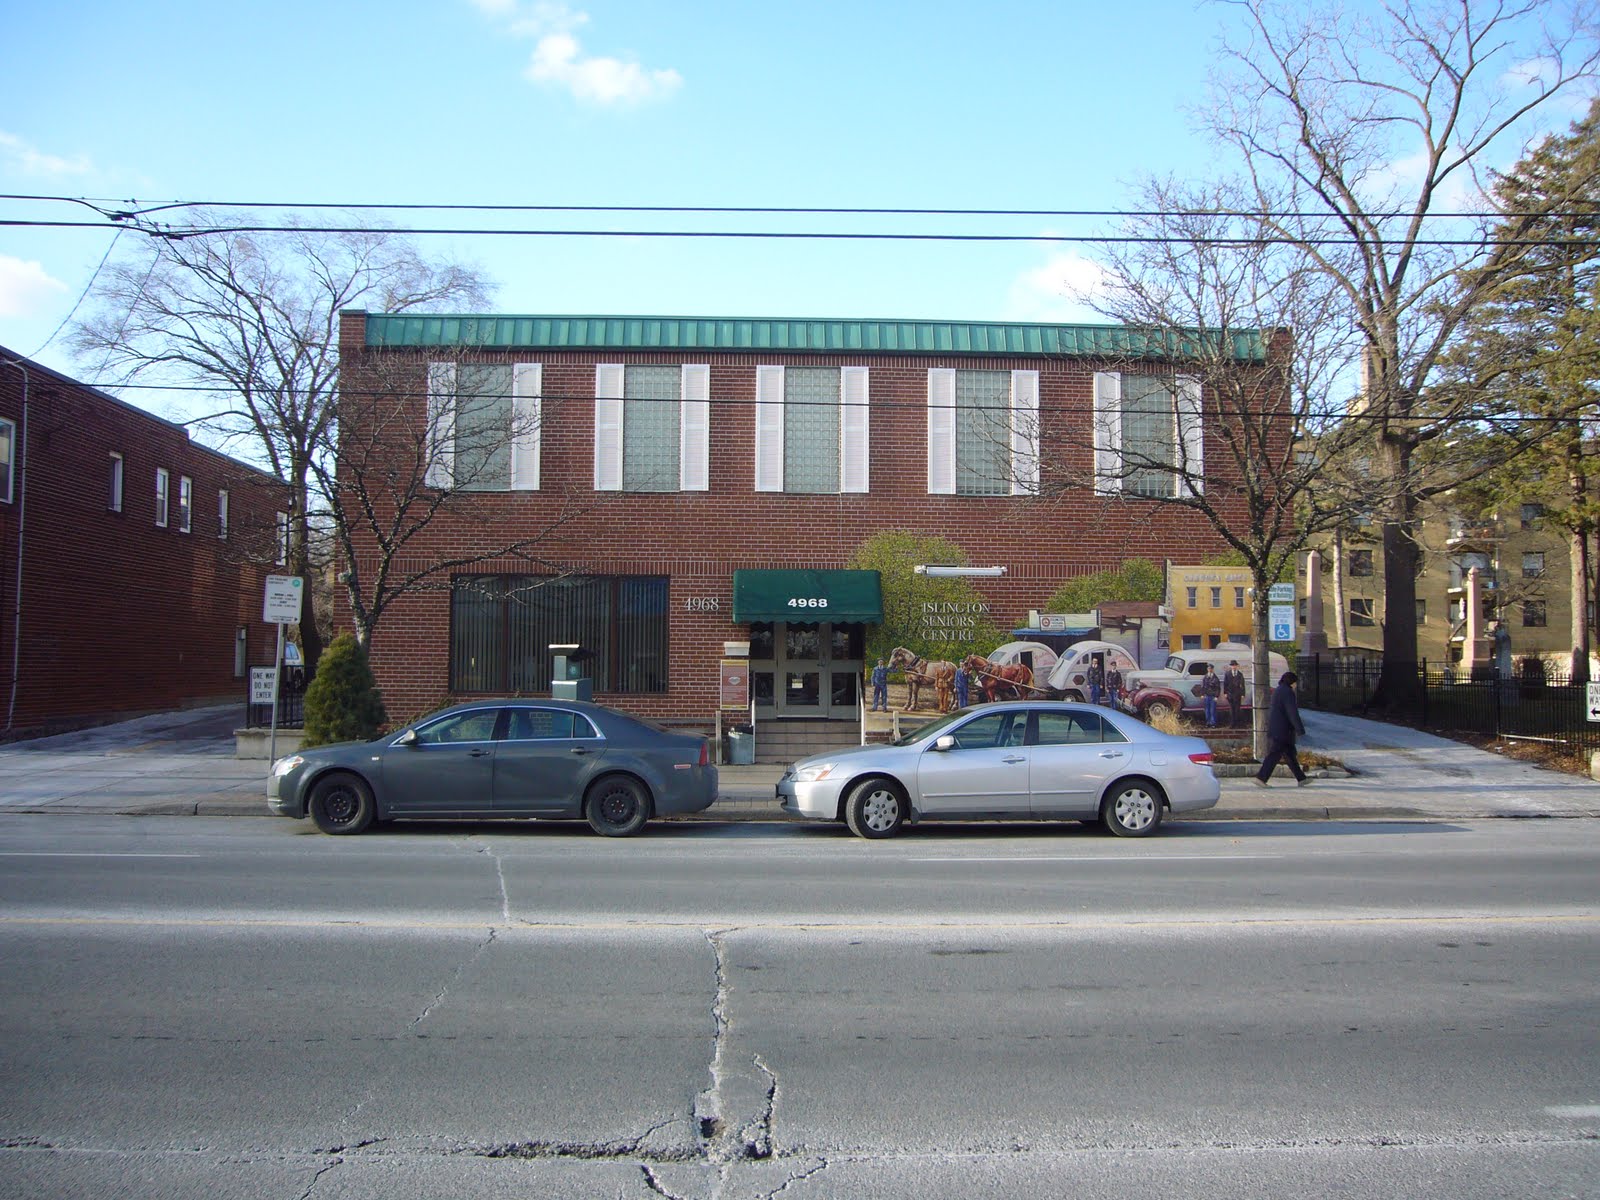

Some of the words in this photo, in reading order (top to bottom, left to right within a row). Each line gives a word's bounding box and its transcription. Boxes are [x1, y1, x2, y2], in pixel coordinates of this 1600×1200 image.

[684, 597, 720, 611] 4968
[788, 598, 828, 608] 4968
[922, 602, 990, 613] ISLINGTON
[922, 629, 975, 641] CENTRE
[253, 672, 263, 680] ONE
[265, 672, 275, 680] WAY
[254, 681, 262, 690] DO
[263, 681, 273, 690] NOT
[255, 691, 272, 699] ENTER
[1589, 696, 1600, 705] WA
